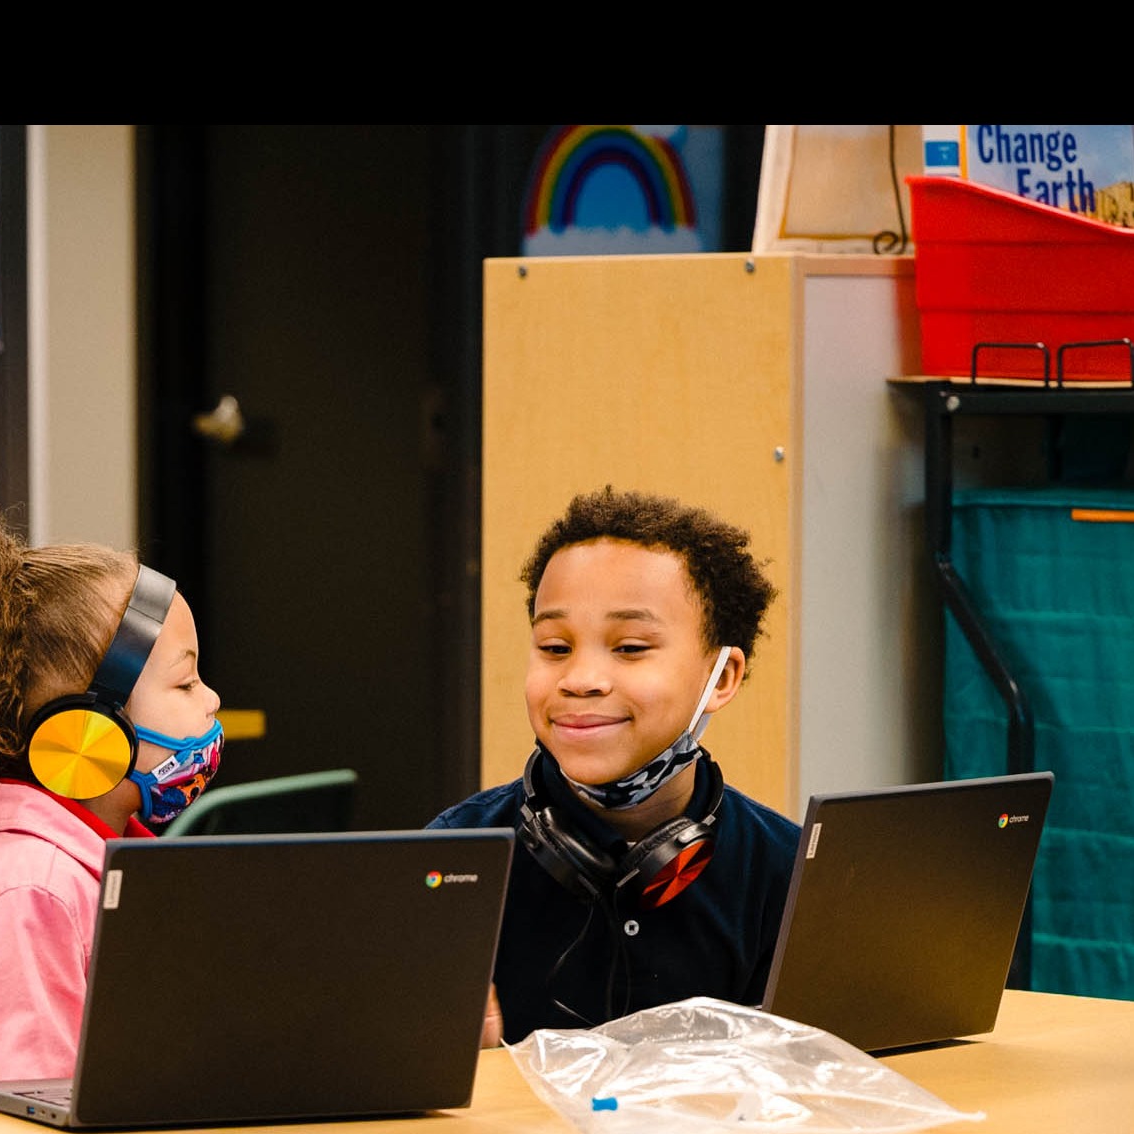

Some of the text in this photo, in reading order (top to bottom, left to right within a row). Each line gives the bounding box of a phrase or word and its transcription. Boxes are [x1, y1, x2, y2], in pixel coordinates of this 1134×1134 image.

[977, 125, 1077, 171] Change
[1017, 168, 1097, 213] Earth
[444, 873, 478, 883] chrome
